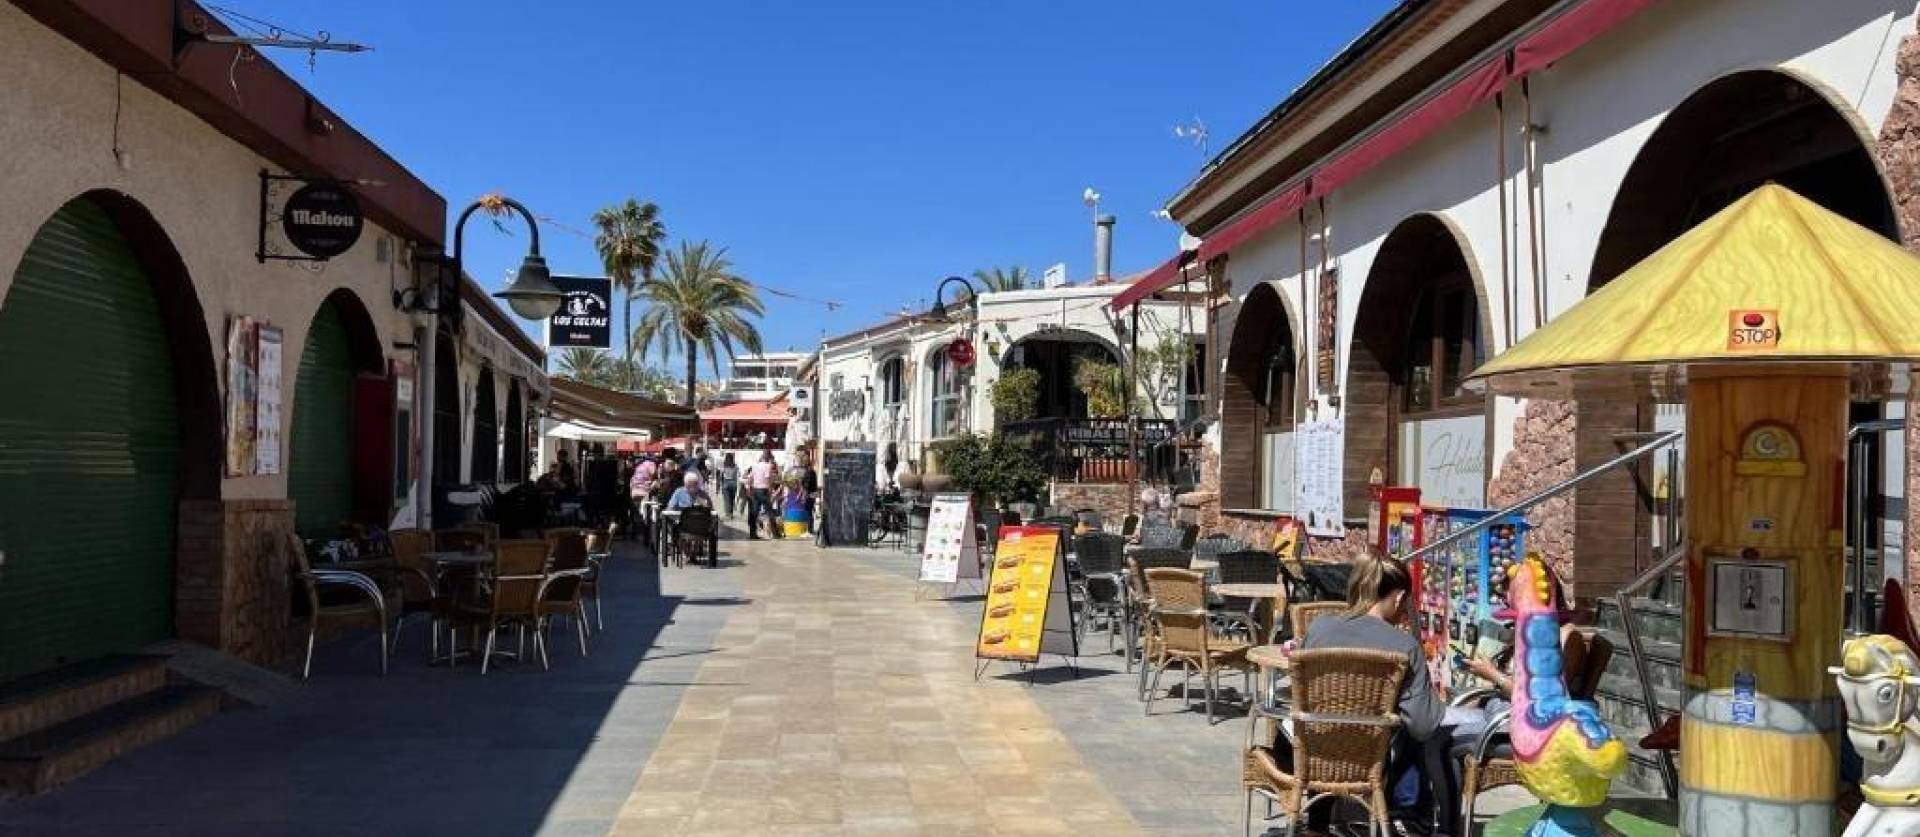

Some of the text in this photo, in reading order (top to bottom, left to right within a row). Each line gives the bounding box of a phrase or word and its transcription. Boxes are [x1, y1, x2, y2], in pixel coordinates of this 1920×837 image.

[293, 210, 355, 226] Mahou
[554, 316, 608, 328] LOS CELTAS
[1732, 328, 1774, 344] STOP
